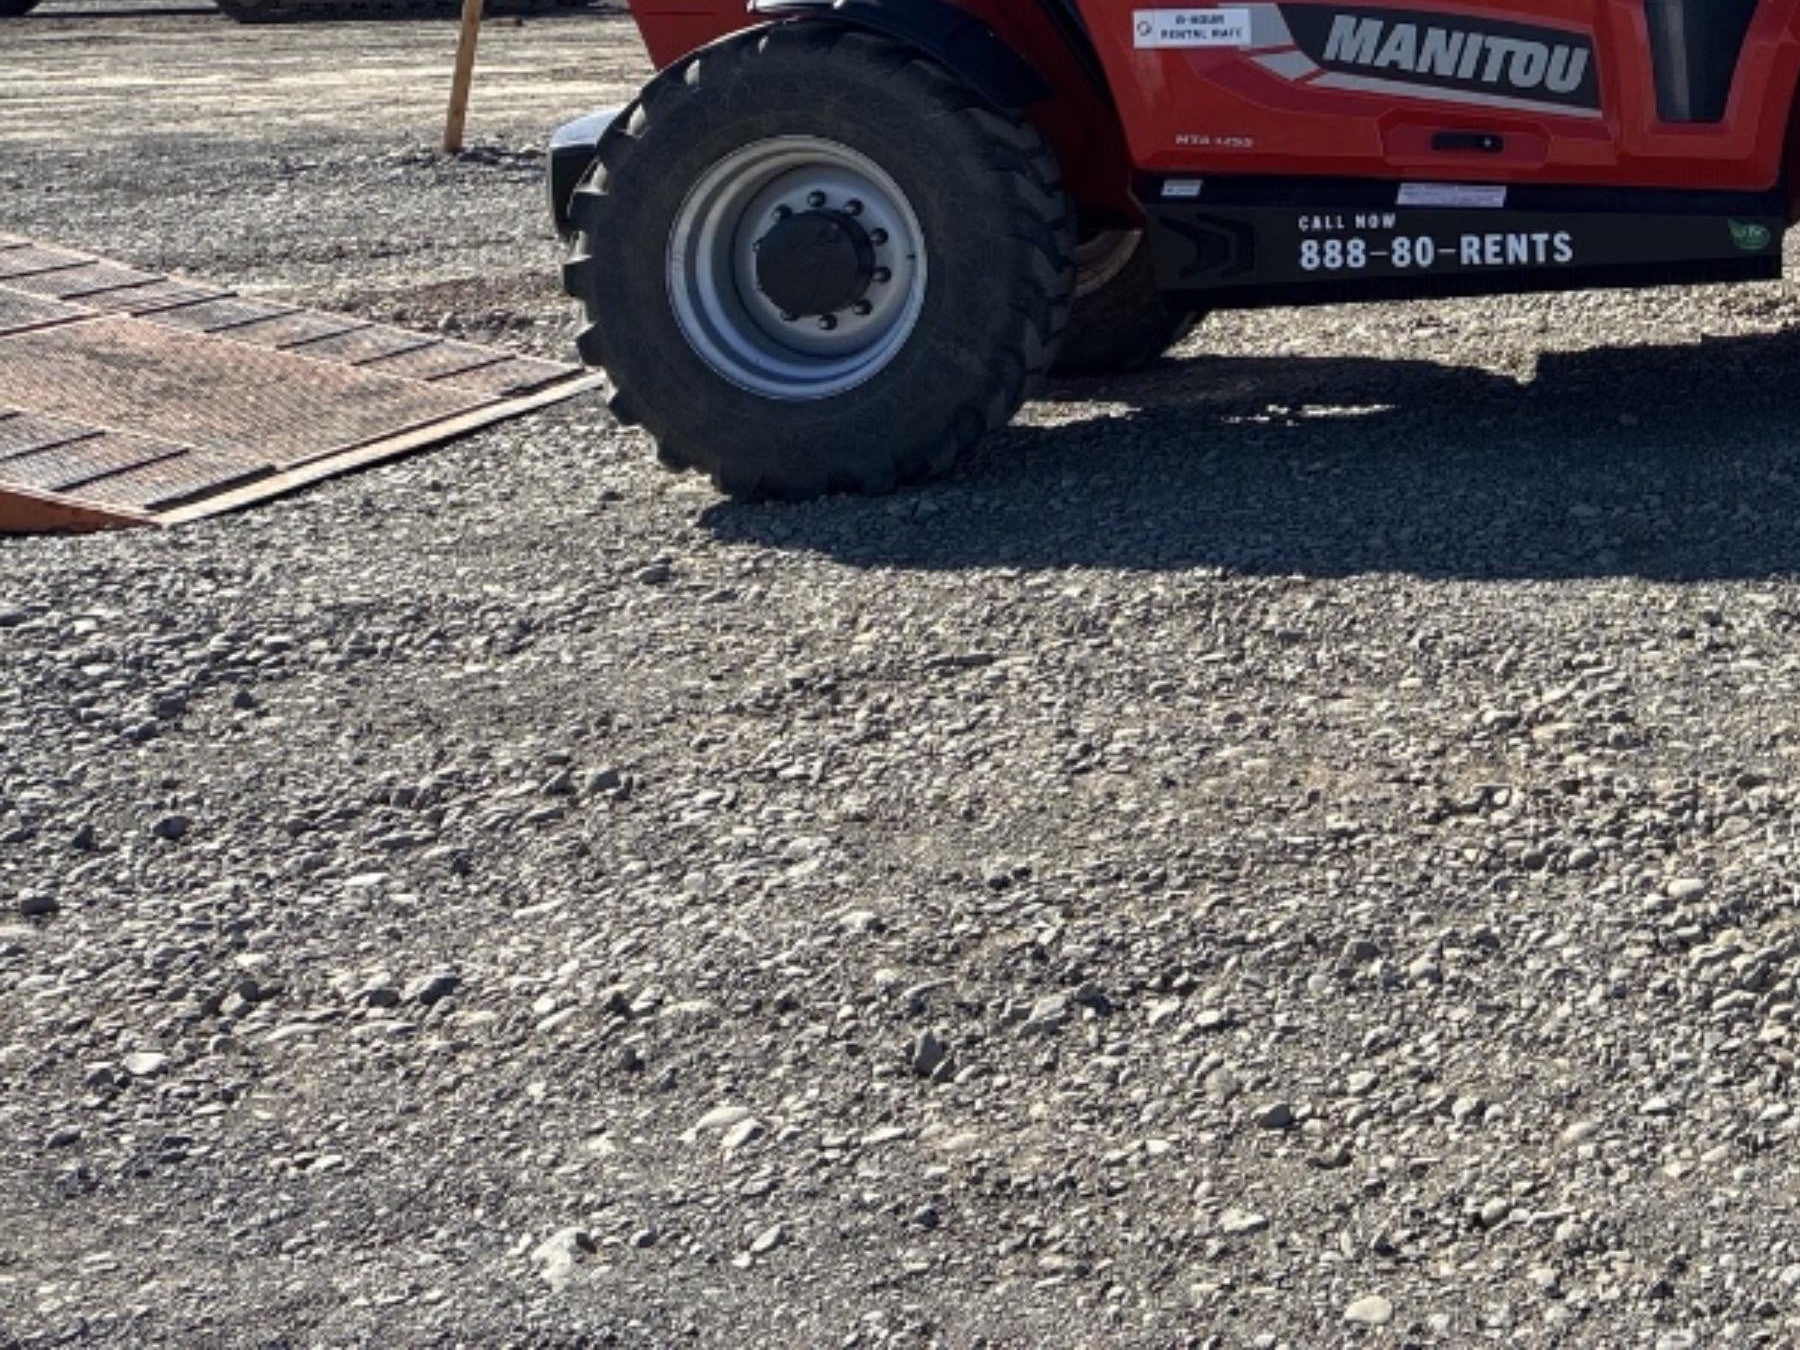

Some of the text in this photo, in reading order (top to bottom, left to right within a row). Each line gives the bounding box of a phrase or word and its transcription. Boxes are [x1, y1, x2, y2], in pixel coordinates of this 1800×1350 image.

[1322, 14, 1590, 93] MANITOU
[1299, 212, 1396, 231] CALL NOW
[1300, 230, 1573, 270] 888-80-RENTS
